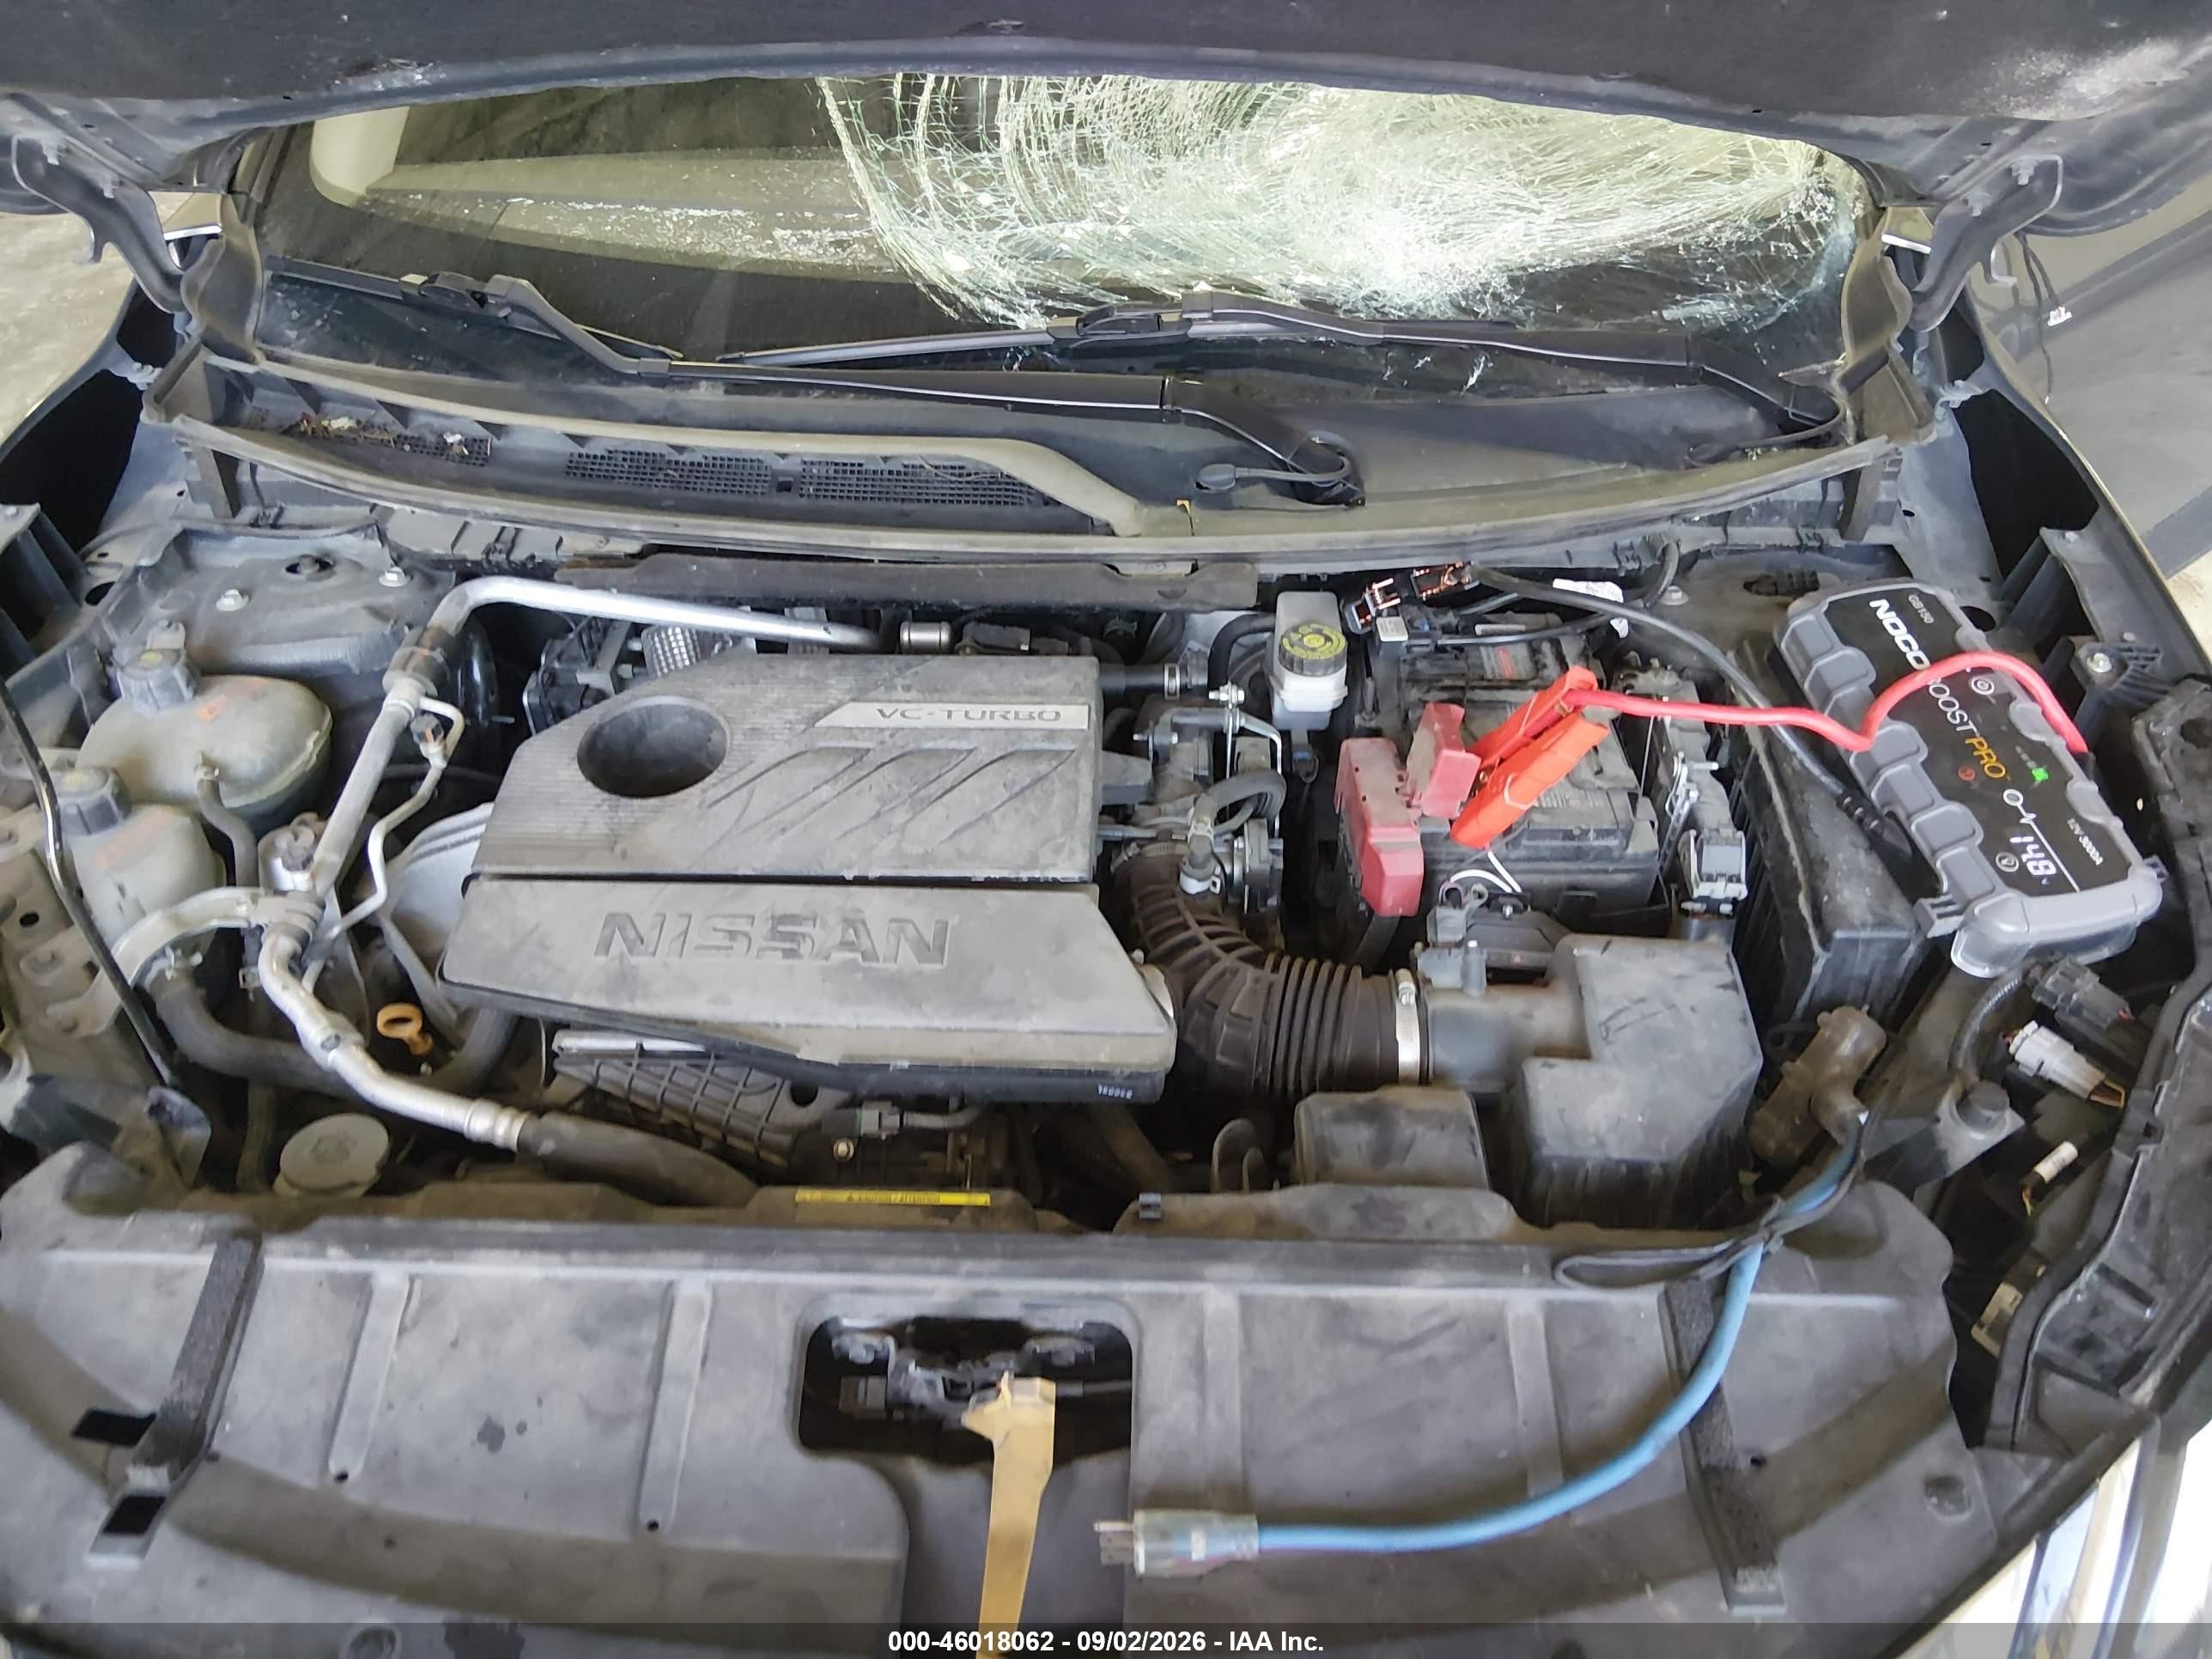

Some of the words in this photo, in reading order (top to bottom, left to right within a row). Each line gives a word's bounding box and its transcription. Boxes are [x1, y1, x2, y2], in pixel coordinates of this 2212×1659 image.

[876, 708, 1061, 722] VC-TURBO
[1869, 599, 1931, 671] NOCO
[1927, 677, 1980, 736] OOST
[1964, 736, 2006, 778] PRO
[593, 912, 950, 966] NISSAN
